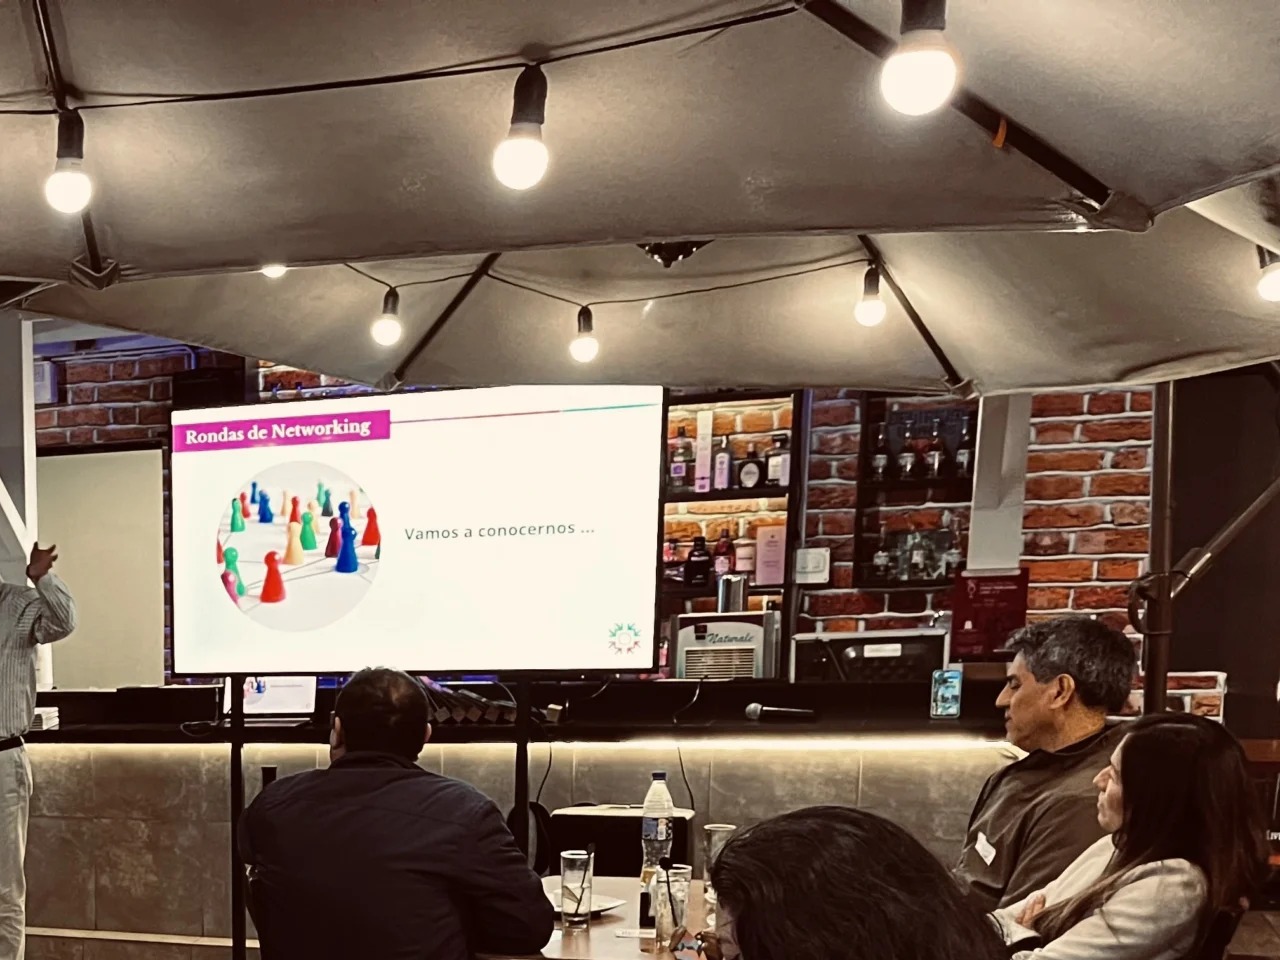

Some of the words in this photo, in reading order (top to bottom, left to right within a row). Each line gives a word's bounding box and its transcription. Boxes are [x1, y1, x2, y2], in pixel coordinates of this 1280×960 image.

[185, 426, 245, 445] Rondas
[247, 424, 268, 441] de
[271, 418, 372, 439] Networking
[404, 527, 459, 540] Vamos
[463, 528, 473, 538] a
[478, 523, 576, 538] conocernos
[706, 633, 754, 644] Naturale
